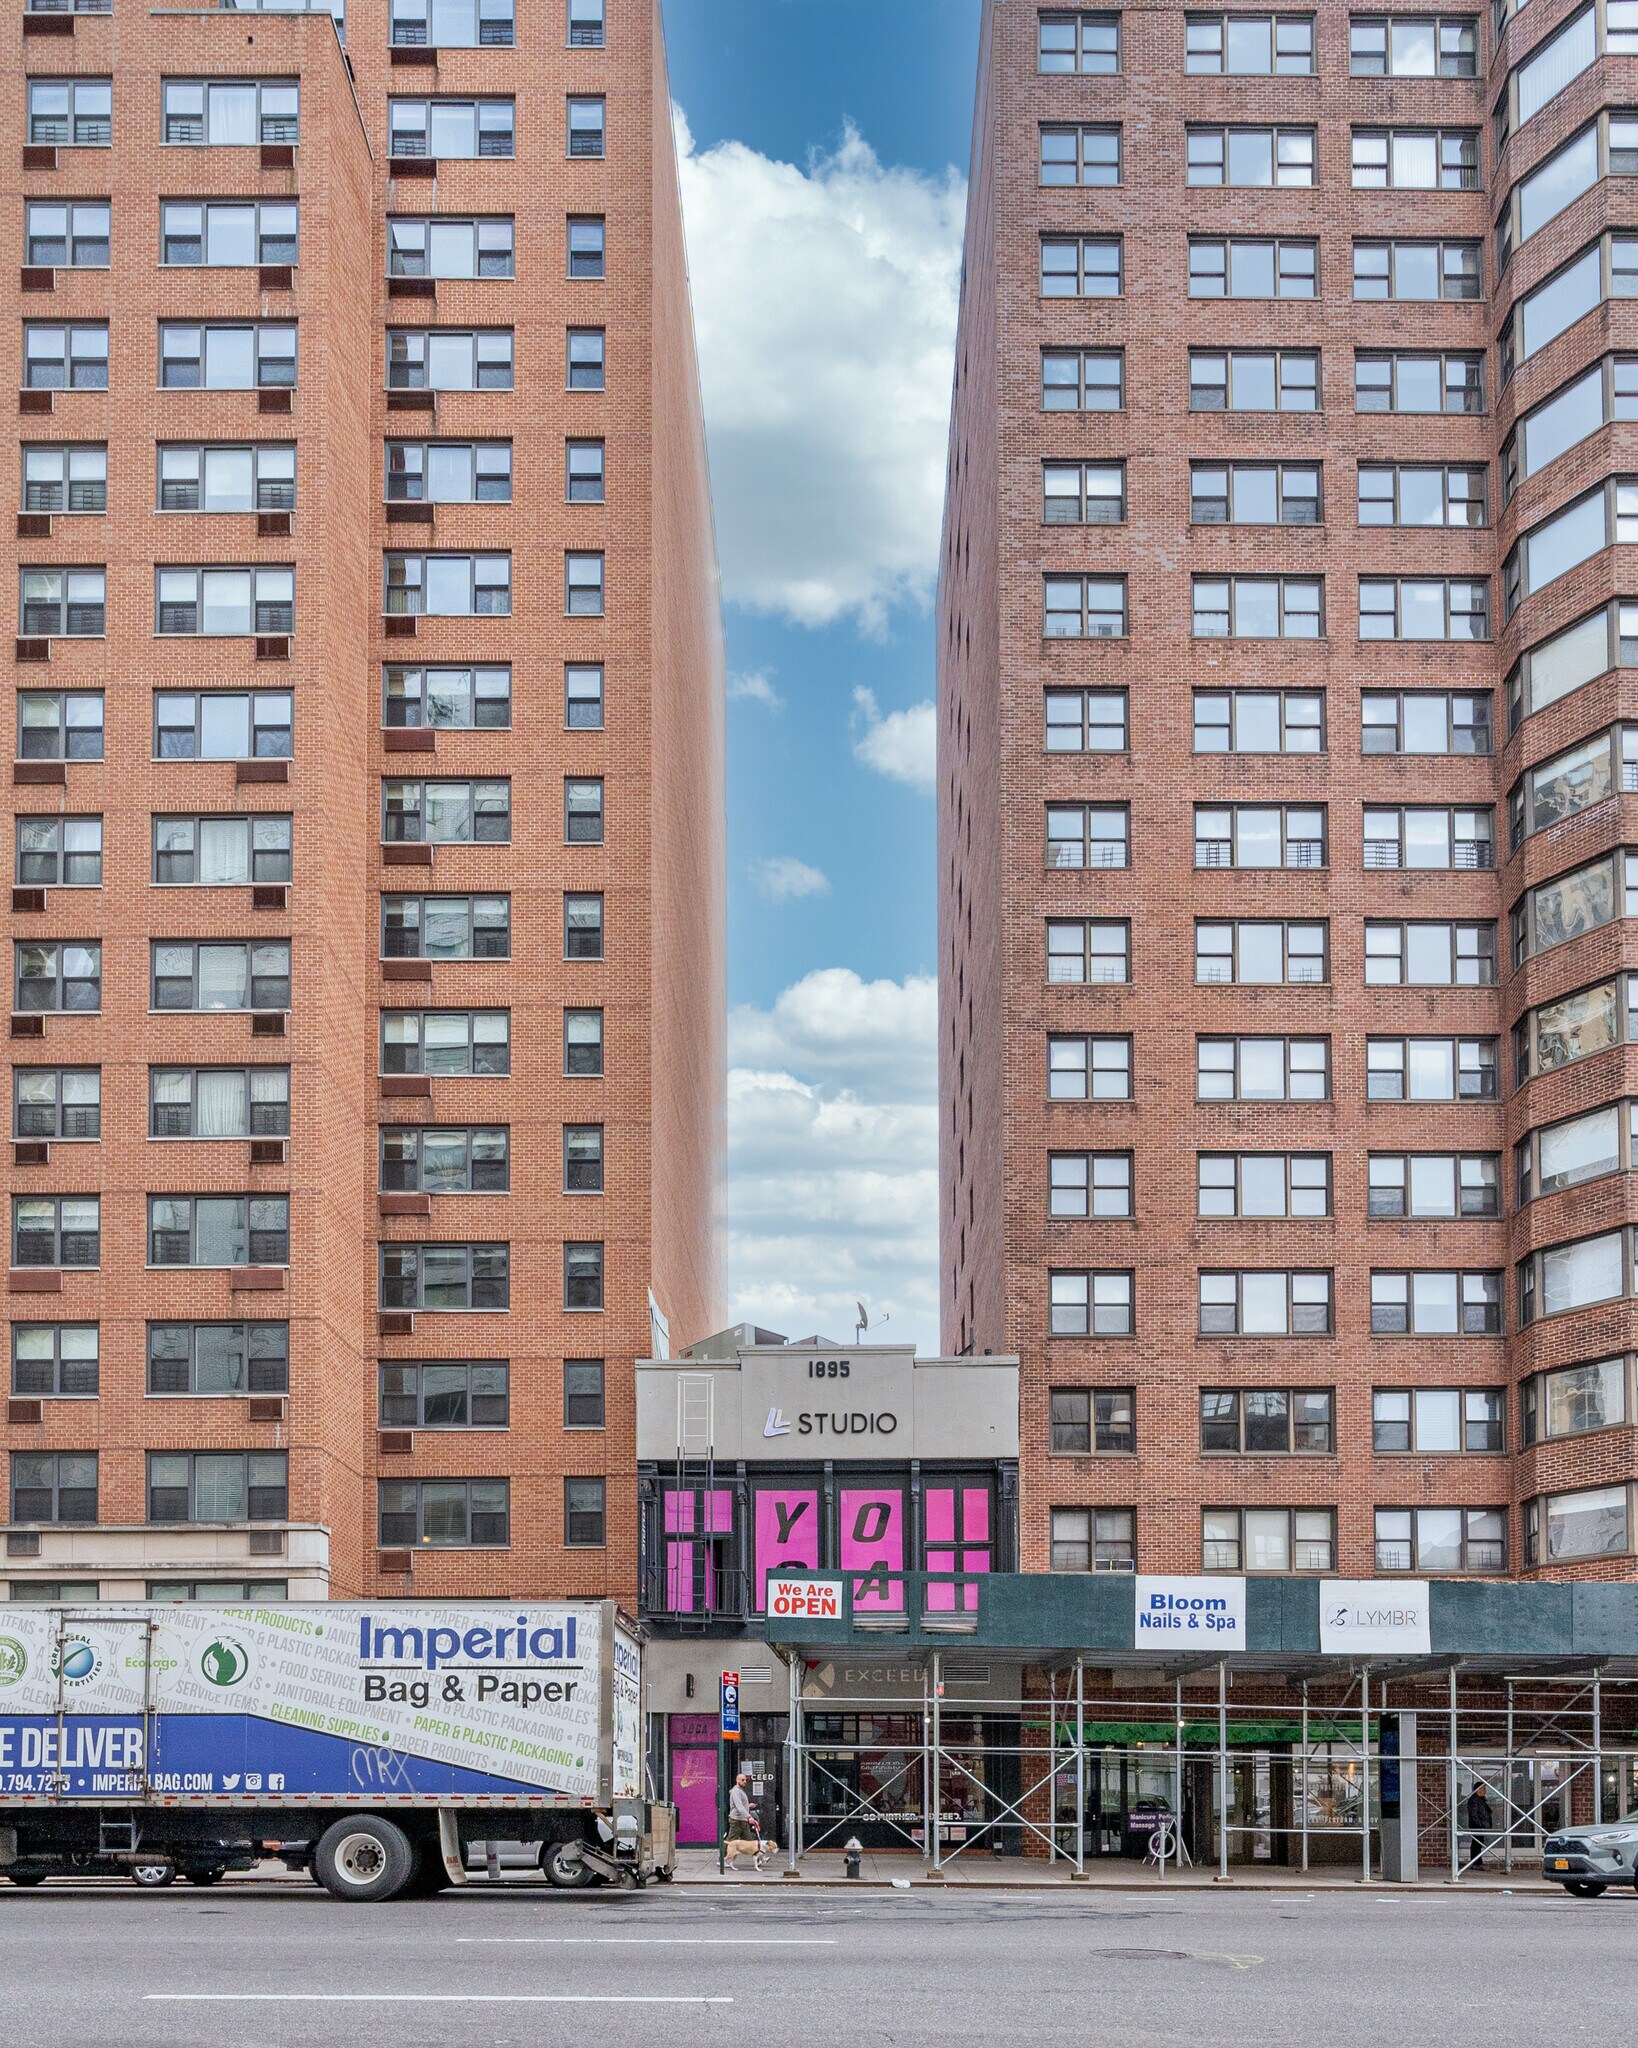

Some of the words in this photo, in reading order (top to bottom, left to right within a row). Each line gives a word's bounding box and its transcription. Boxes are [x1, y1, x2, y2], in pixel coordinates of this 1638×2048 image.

[808, 1360, 850, 1378] 1895
[798, 1412, 898, 1435] STUDIO
[778, 1583, 802, 1596] We
[806, 1583, 834, 1597] Are
[1150, 1593, 1227, 1611] Bloom
[773, 1597, 837, 1616] OPEN
[1356, 1610, 1418, 1626] LYMBR
[254, 1610, 313, 1636] PRODUCTS
[1139, 1612, 1181, 1629] Nails
[1188, 1613, 1200, 1629] &
[1205, 1613, 1236, 1632] Spa
[266, 1633, 313, 1657] PLASTIC
[361, 1616, 577, 1670] Imperial
[63, 1660, 103, 1687] CERTIFIED
[278, 1660, 309, 1680] FOOD
[310, 1666, 358, 1692] SERVICE
[365, 1675, 429, 1709] Bag
[442, 1675, 465, 1702] &
[477, 1675, 578, 1709] Paper
[273, 1681, 335, 1709] JANITORIAL
[337, 1697, 403, 1726] EQUIPMENT
[413, 1715, 451, 1738] PAPER
[451, 1725, 461, 1740] &
[462, 1727, 508, 1752] PLASTIC
[509, 1737, 574, 1768] PACKAGING
[453, 1701, 500, 1727] PLASTIC
[500, 1714, 565, 1743] PACKAGING
[21, 1727, 144, 1768] DELIVER
[270, 1702, 326, 1729] CLEANING
[327, 1715, 380, 1742] SUPPLIES
[391, 1732, 430, 1755] PAPER
[430, 1743, 490, 1769] PRODUCTS
[499, 1758, 563, 1788] JANITORIAL
[1129, 1813, 1156, 1821] Manicure
[1129, 1822, 1155, 1830] Massage
